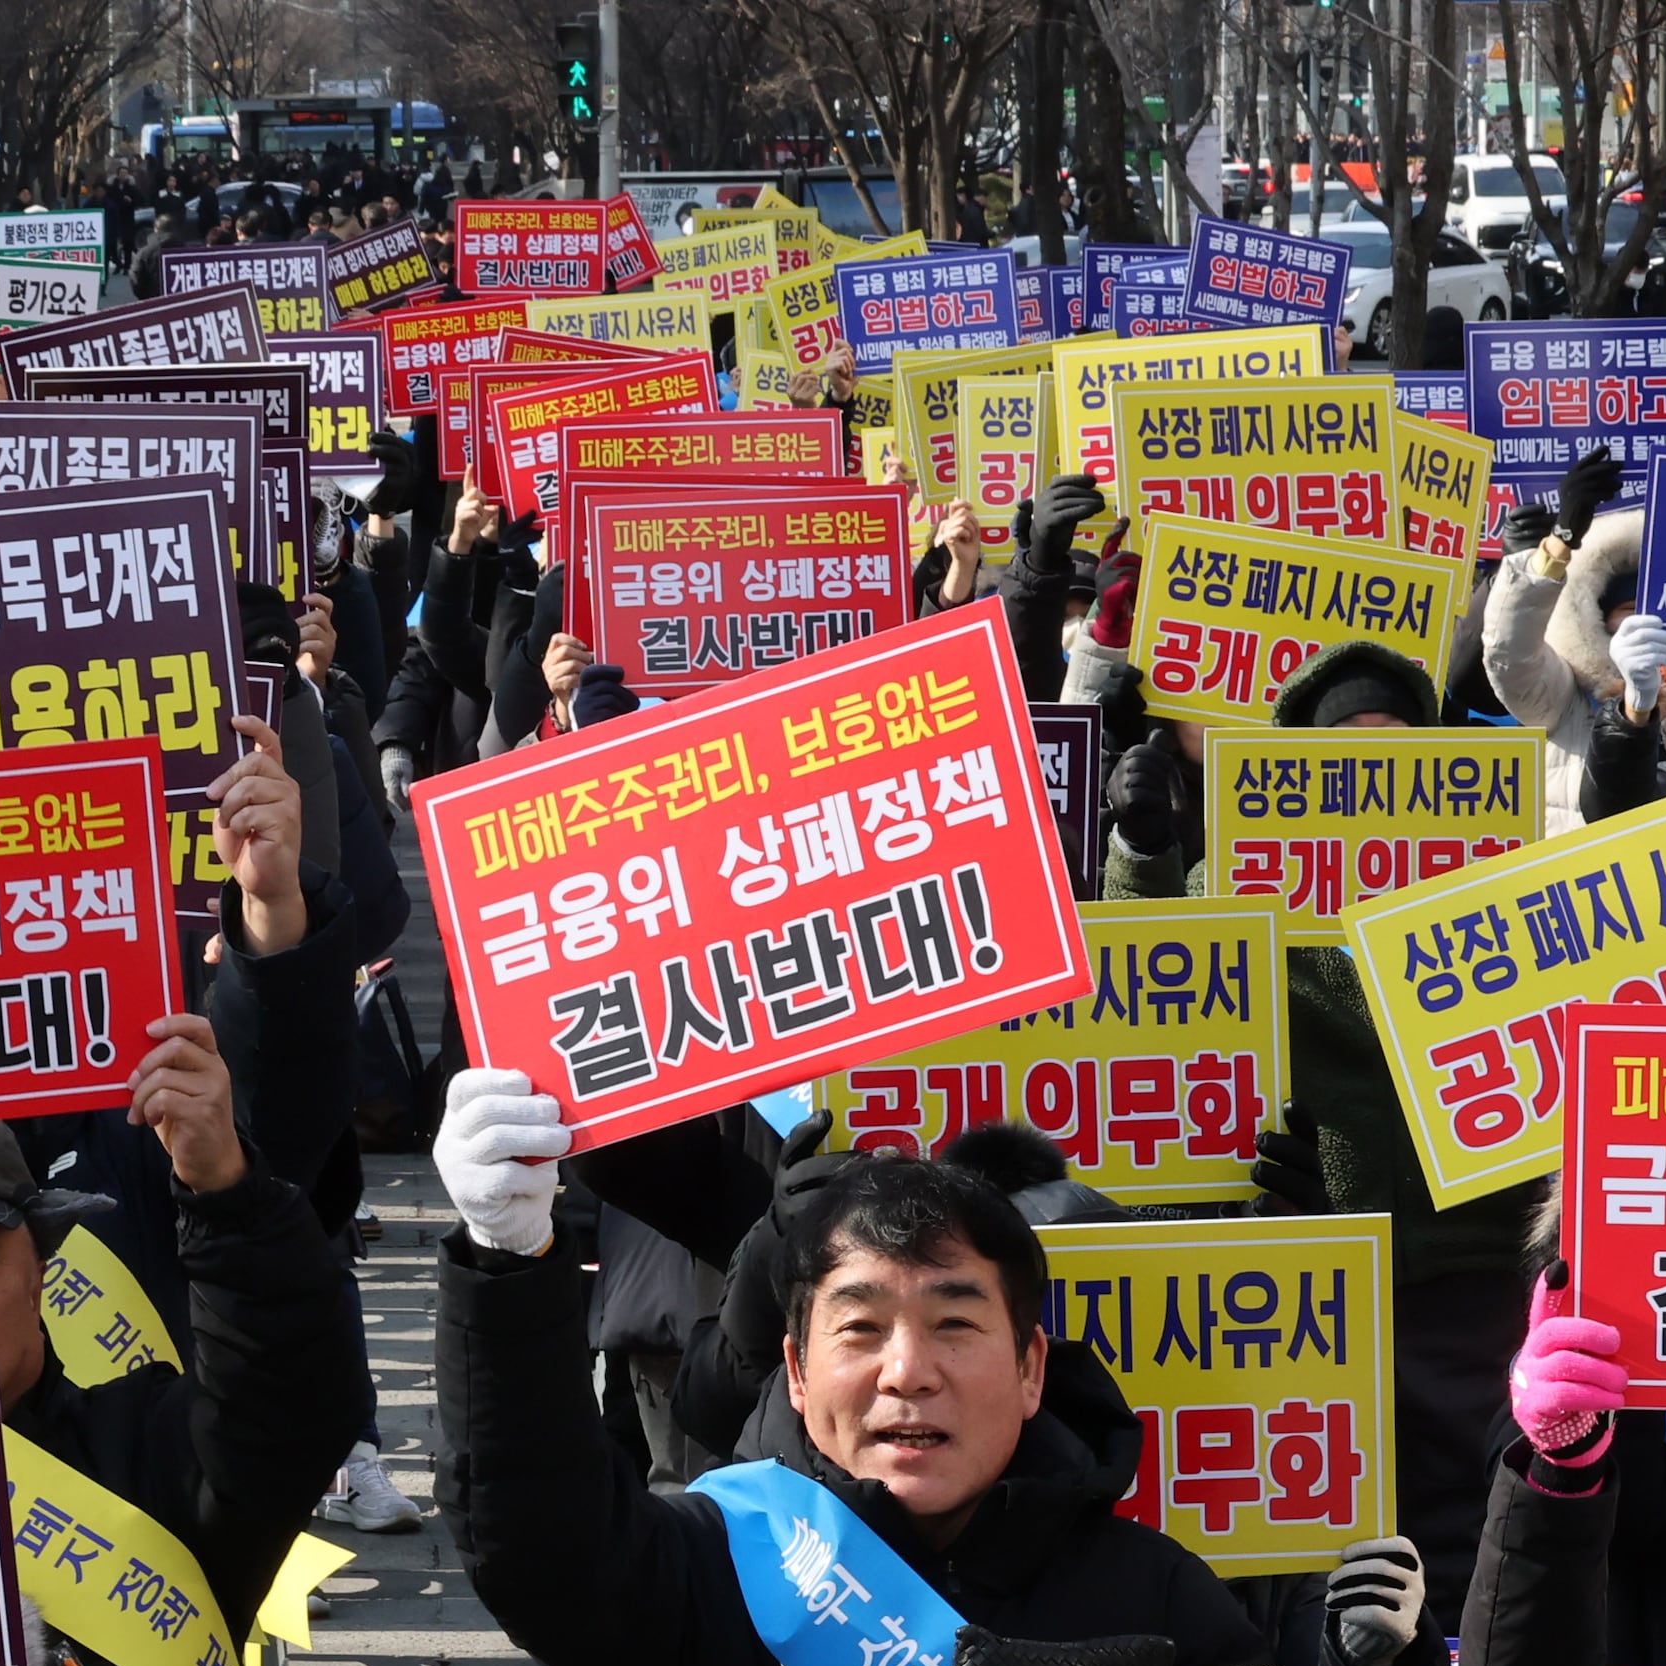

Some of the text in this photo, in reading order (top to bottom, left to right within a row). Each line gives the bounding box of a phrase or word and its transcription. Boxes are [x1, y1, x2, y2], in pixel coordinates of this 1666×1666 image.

[549, 212, 598, 230] 보호없는
[464, 233, 598, 256] 금융위 상폐정책
[662, 251, 689, 274] 상장
[1209, 229, 1336, 272] 금융 범죄 카르텔은
[369, 255, 429, 297] 허용하라
[475, 259, 589, 287] 결사반대!
[854, 261, 998, 295] 금융 범죄 카르텔은
[1210, 253, 1329, 309] 엄벌하고
[8, 278, 87, 316] 평가요소
[861, 289, 998, 335] 엄벌하고
[473, 309, 524, 332] 보호없는
[636, 305, 696, 337] 사유서
[393, 346, 448, 368] 금융위
[1490, 340, 1534, 371] 금융
[1545, 339, 1591, 370] 범죄
[509, 372, 699, 431] 피해주주권리, 보호없는
[980, 396, 1034, 437] 상장
[578, 431, 821, 469] 피해주주권리, 보호없는
[1138, 402, 1378, 461] 상장 폐지 사유서
[1247, 470, 1387, 540] 의무화
[613, 510, 885, 554] 피해주주권리, 보호없는
[611, 555, 890, 606] 금융위 상폐정책
[1167, 544, 1434, 639] 상장 폐지 사유서
[1152, 617, 1260, 705] 공개
[464, 670, 980, 879] 피해주주권리, 보호없는
[1234, 756, 1520, 819] 상장 폐지 사유서
[477, 745, 1009, 986] 금융위 상폐정책
[1403, 904, 1518, 1014] 상장
[1517, 861, 1644, 972] 폐지
[548, 860, 1005, 1103] 결사반대!
[1090, 939, 1251, 1028] 사유서
[1024, 1050, 1268, 1169] 의무화
[1129, 1203, 1192, 1221] scovery
[1153, 1268, 1346, 1370] 사유서
